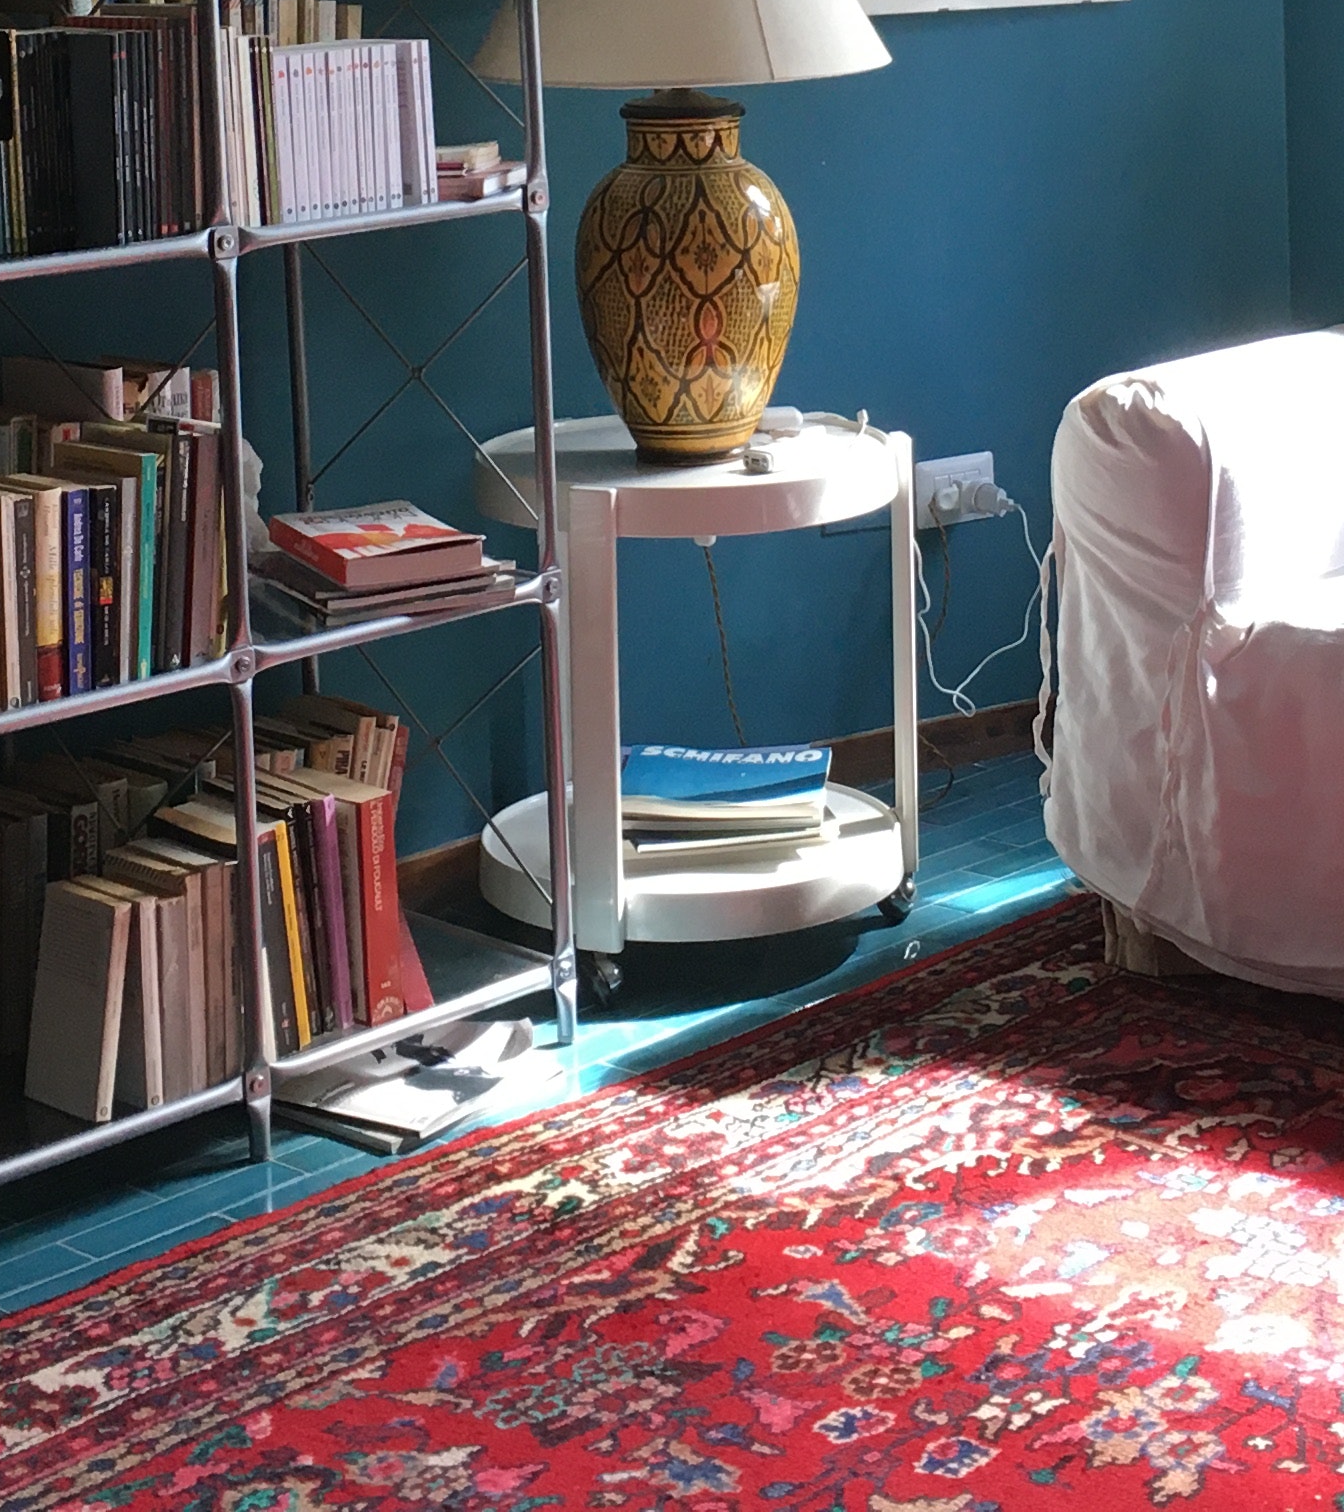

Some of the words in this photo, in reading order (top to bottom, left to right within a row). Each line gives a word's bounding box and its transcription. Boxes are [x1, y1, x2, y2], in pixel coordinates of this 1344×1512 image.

[640, 745, 823, 765] SCHIFANO
[369, 813, 382, 853] PENDOLO
[372, 866, 384, 912] FOUCAULT
